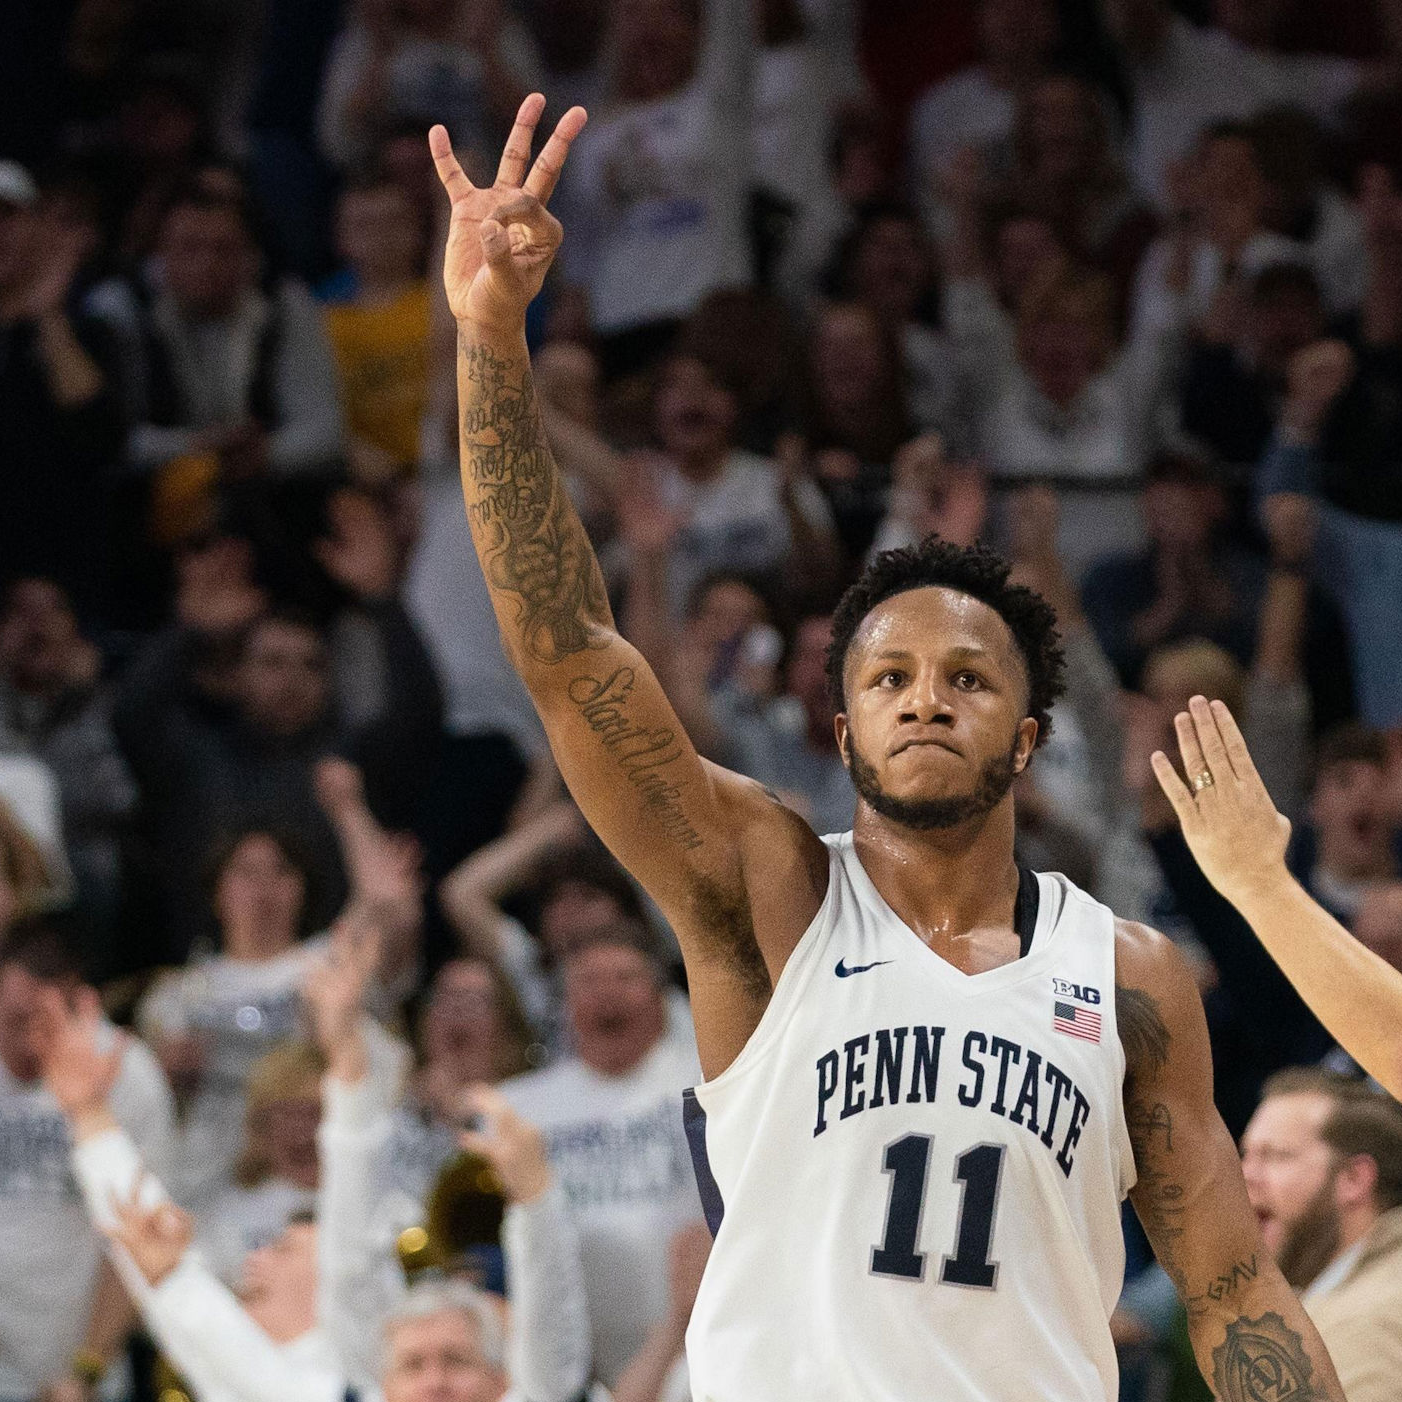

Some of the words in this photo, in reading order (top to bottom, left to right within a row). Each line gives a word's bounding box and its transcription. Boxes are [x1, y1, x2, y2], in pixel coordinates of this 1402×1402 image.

[813, 1025, 946, 1139] PENN
[957, 1031, 1091, 1179] STATE
[868, 1131, 1008, 1292] 11
